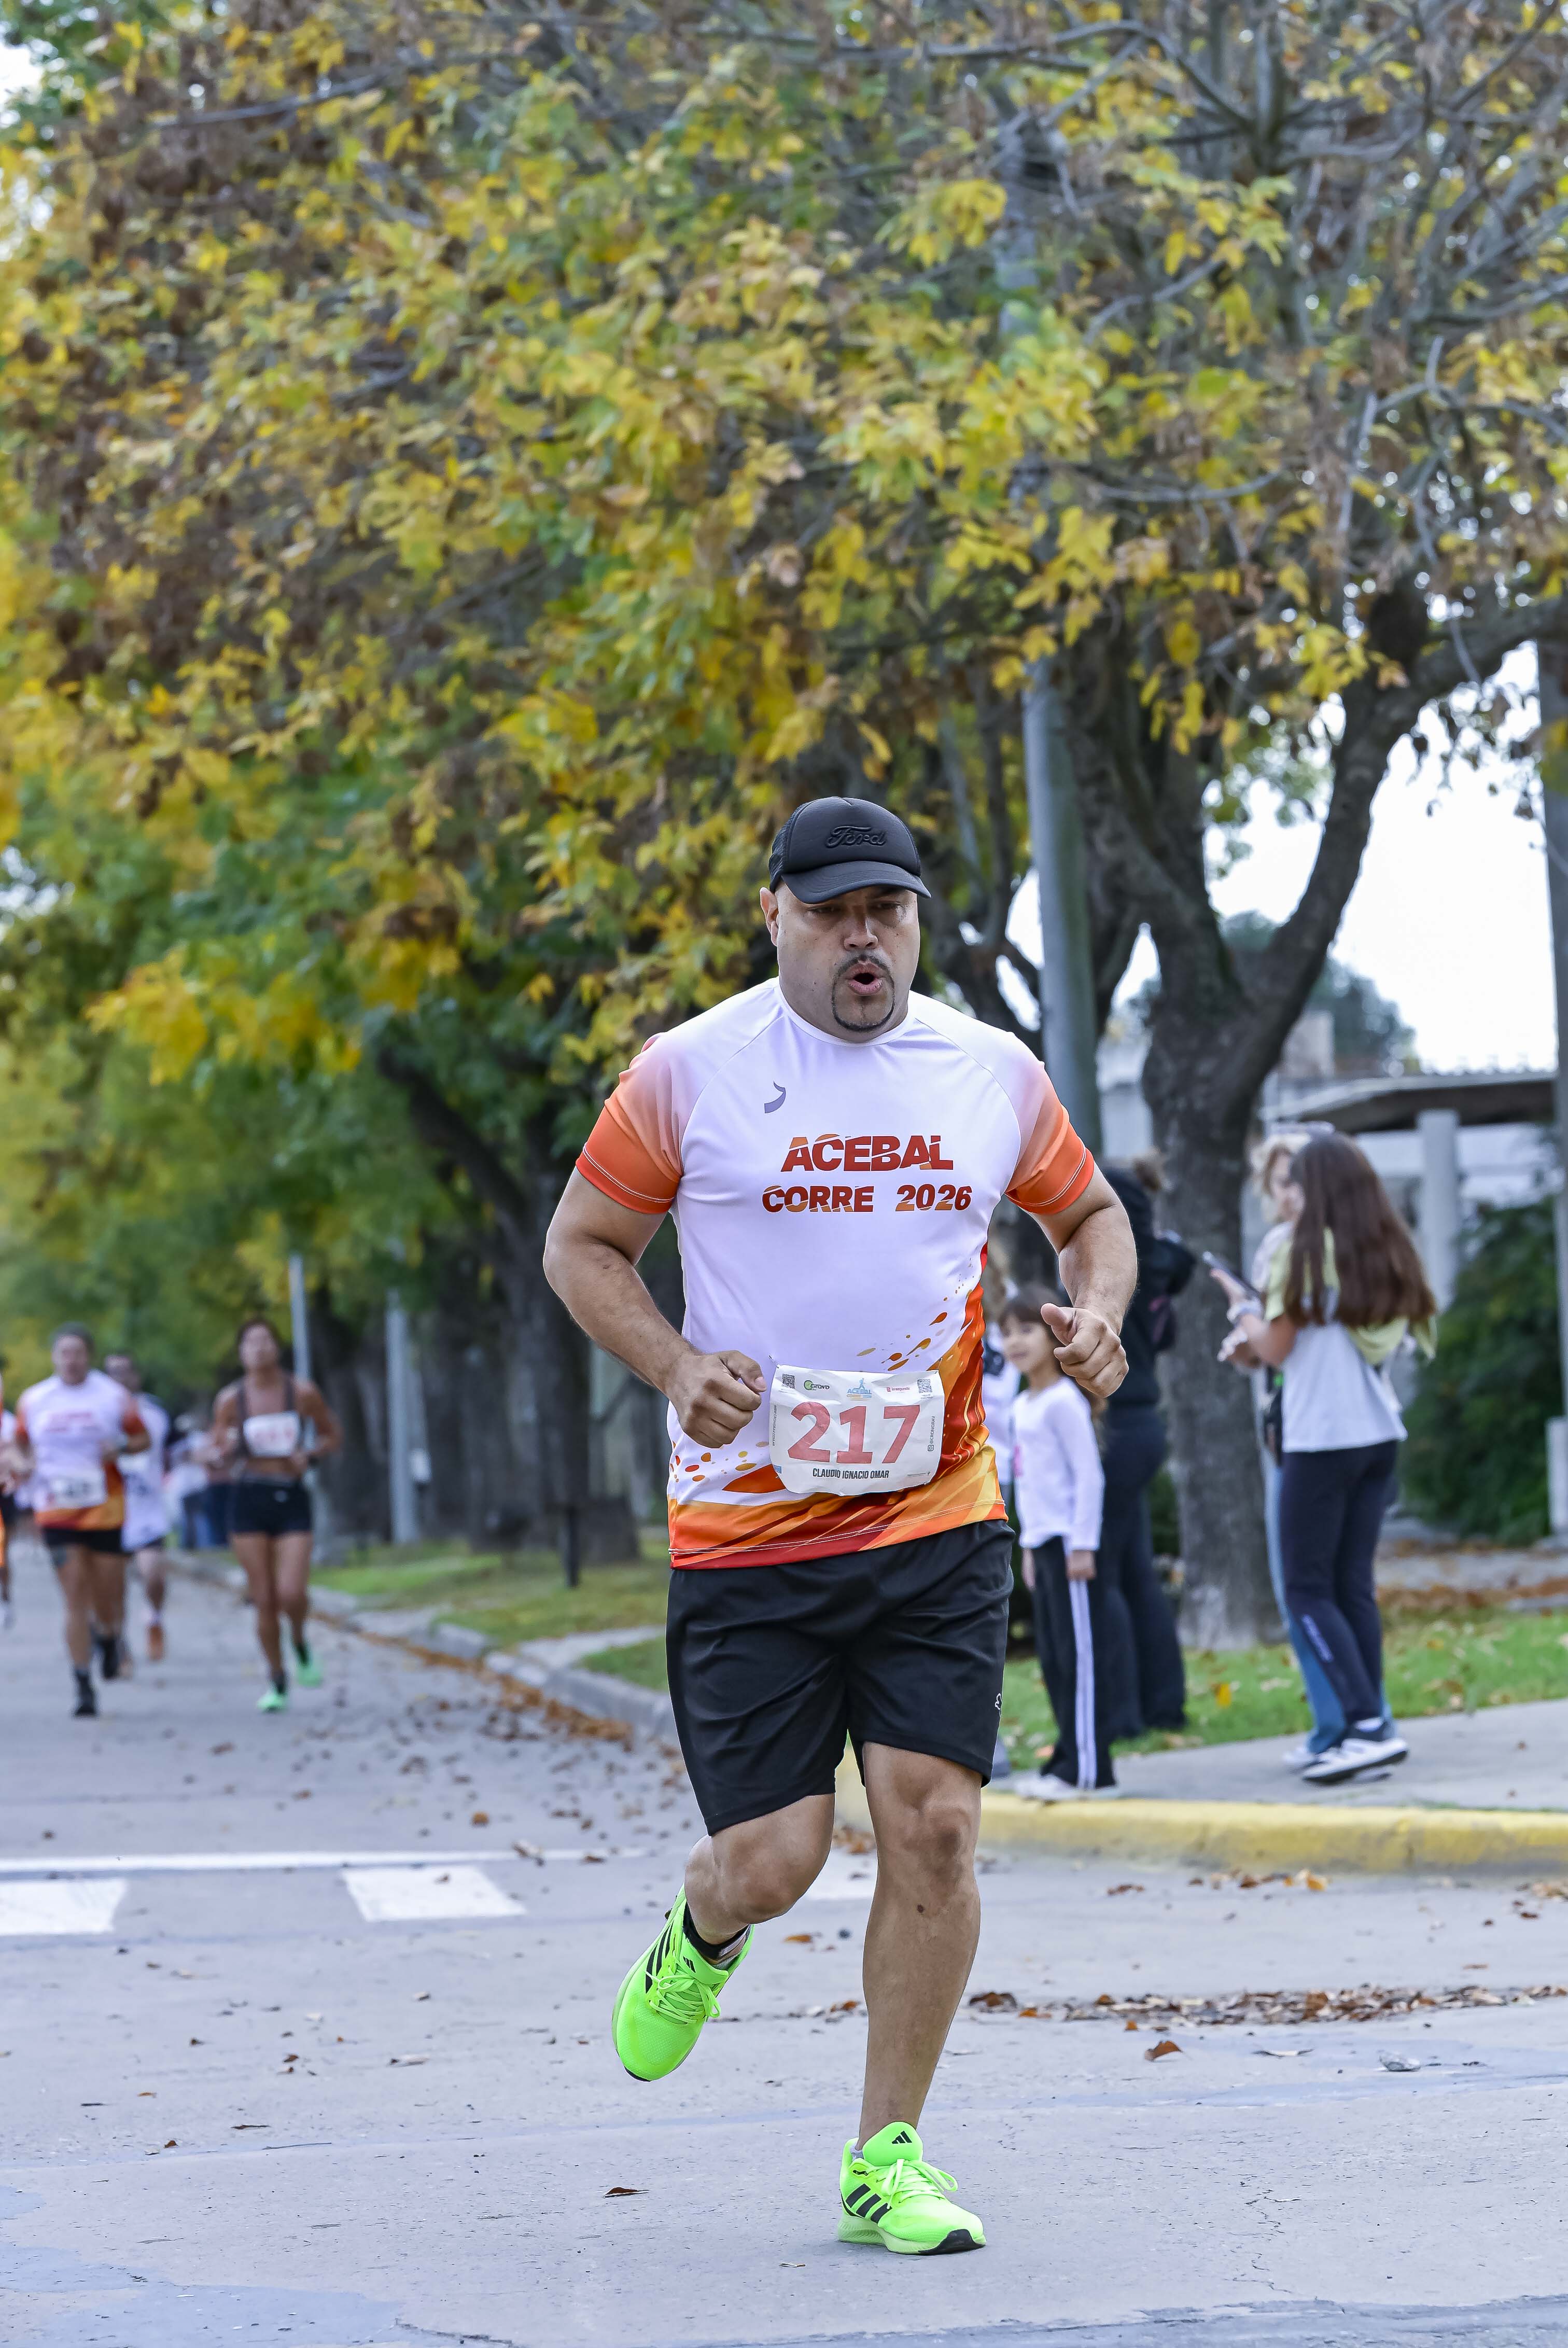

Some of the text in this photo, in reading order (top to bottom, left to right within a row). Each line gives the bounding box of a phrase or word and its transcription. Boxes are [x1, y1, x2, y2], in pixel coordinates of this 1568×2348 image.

[825, 826, 888, 849] Ford
[780, 1134, 954, 1172] ACEBAL
[762, 1184, 973, 1212] CORRE 2026
[788, 1401, 920, 1464] 217
[813, 1468, 890, 1479] CLAUDIO IGNACIO OMAR
